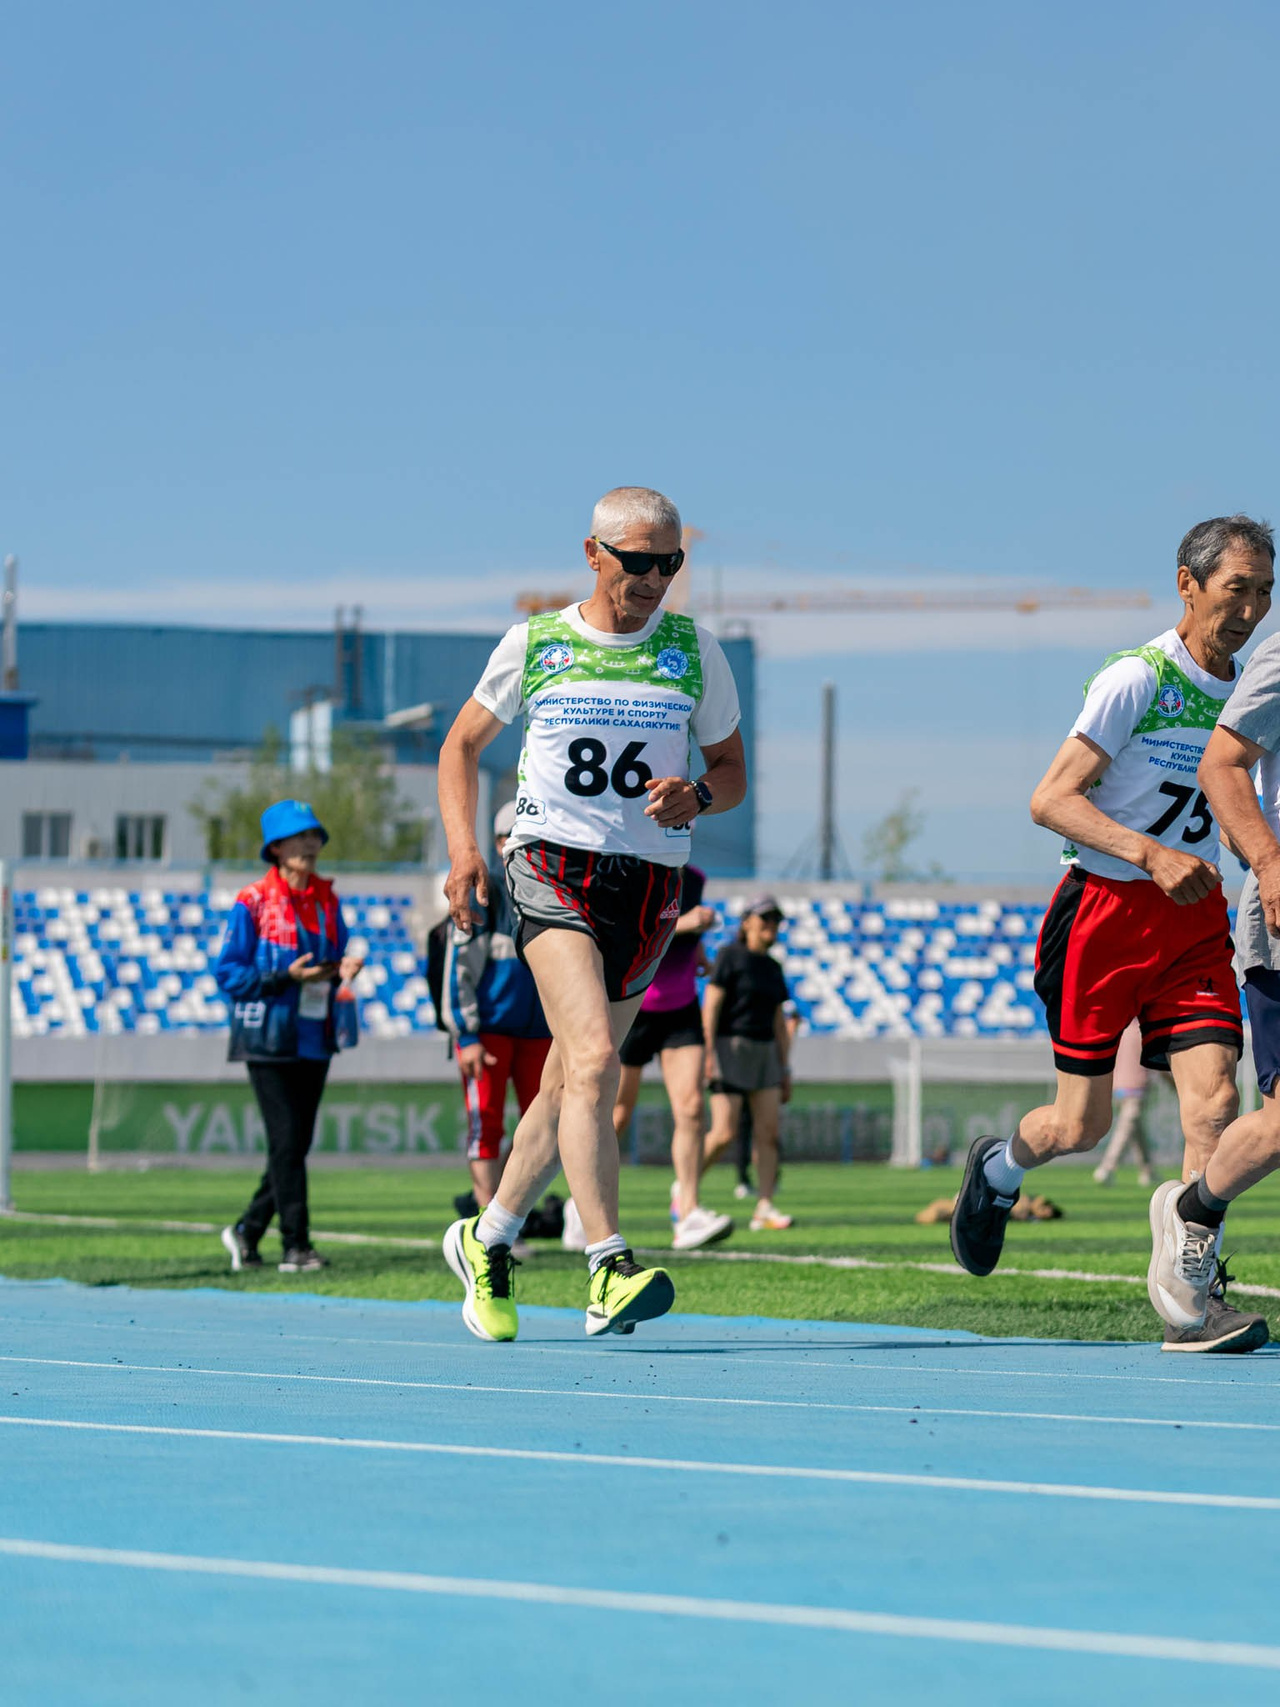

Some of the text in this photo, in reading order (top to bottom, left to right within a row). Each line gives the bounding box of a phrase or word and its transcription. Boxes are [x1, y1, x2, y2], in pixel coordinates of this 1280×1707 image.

[563, 707, 614, 716] КУЛЬТУРЕ
[628, 709, 667, 719] СПОРТУ
[564, 737, 653, 798] 86
[1146, 781, 1213, 843] 75
